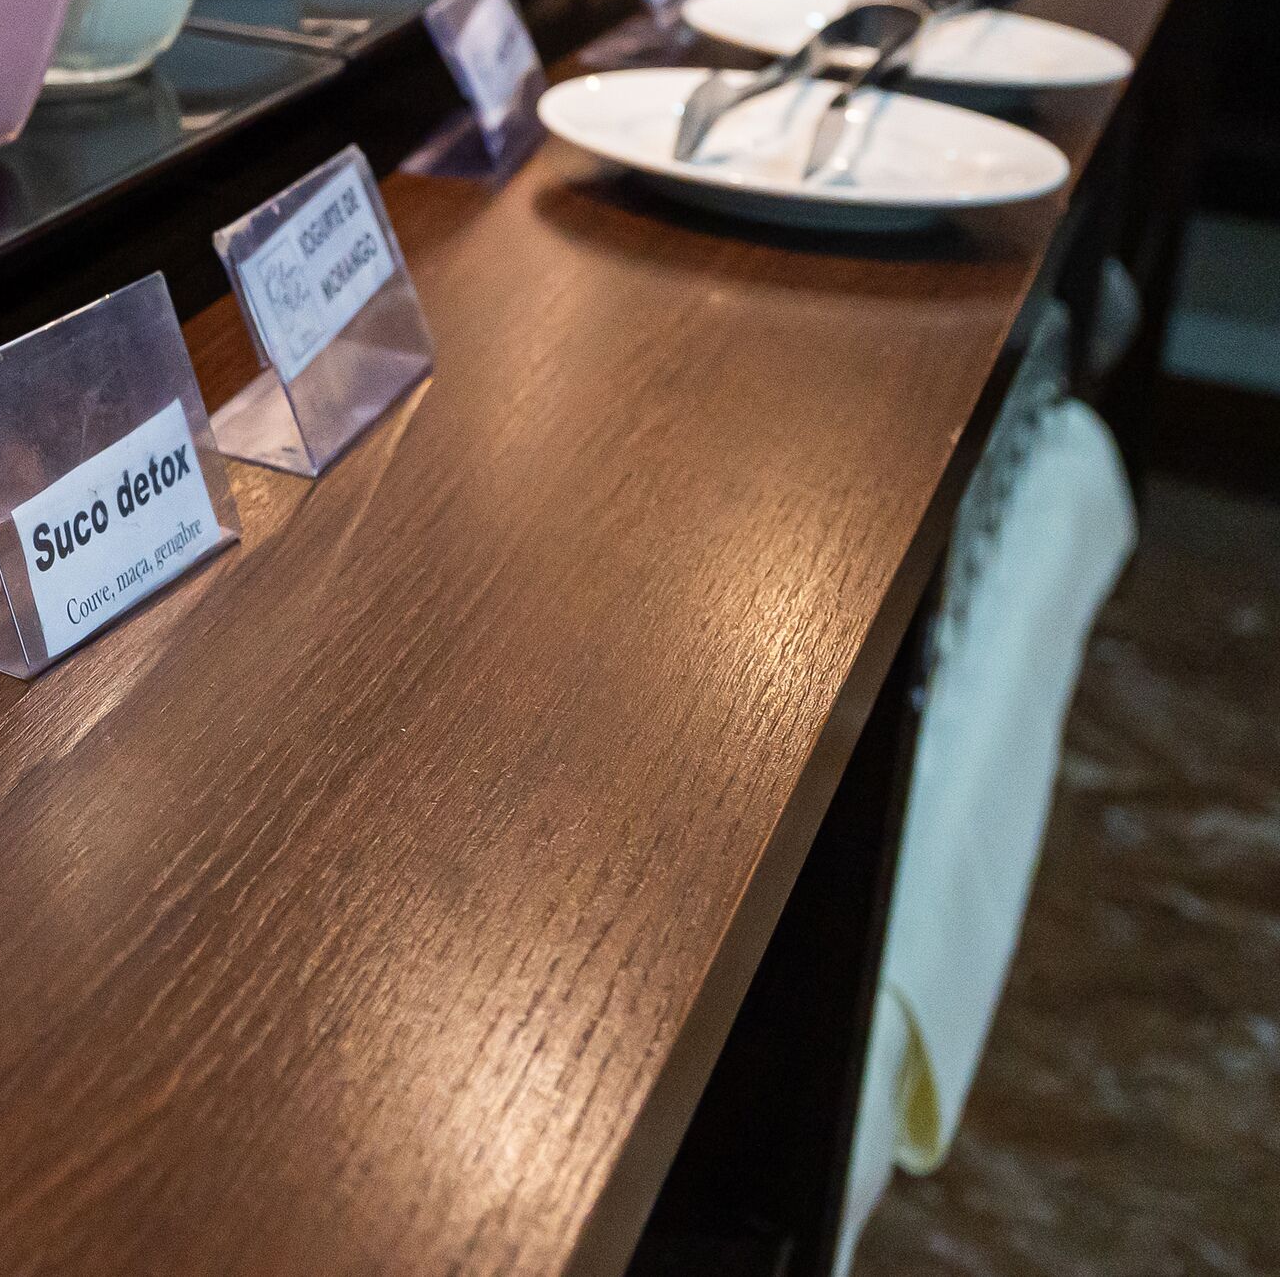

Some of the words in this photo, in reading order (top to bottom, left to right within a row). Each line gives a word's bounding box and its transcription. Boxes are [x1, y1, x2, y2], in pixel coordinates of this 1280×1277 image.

[32, 500, 109, 571] Suco
[116, 444, 191, 518] detox
[66, 576, 116, 625] Couve,
[153, 520, 202, 567] gengibre
